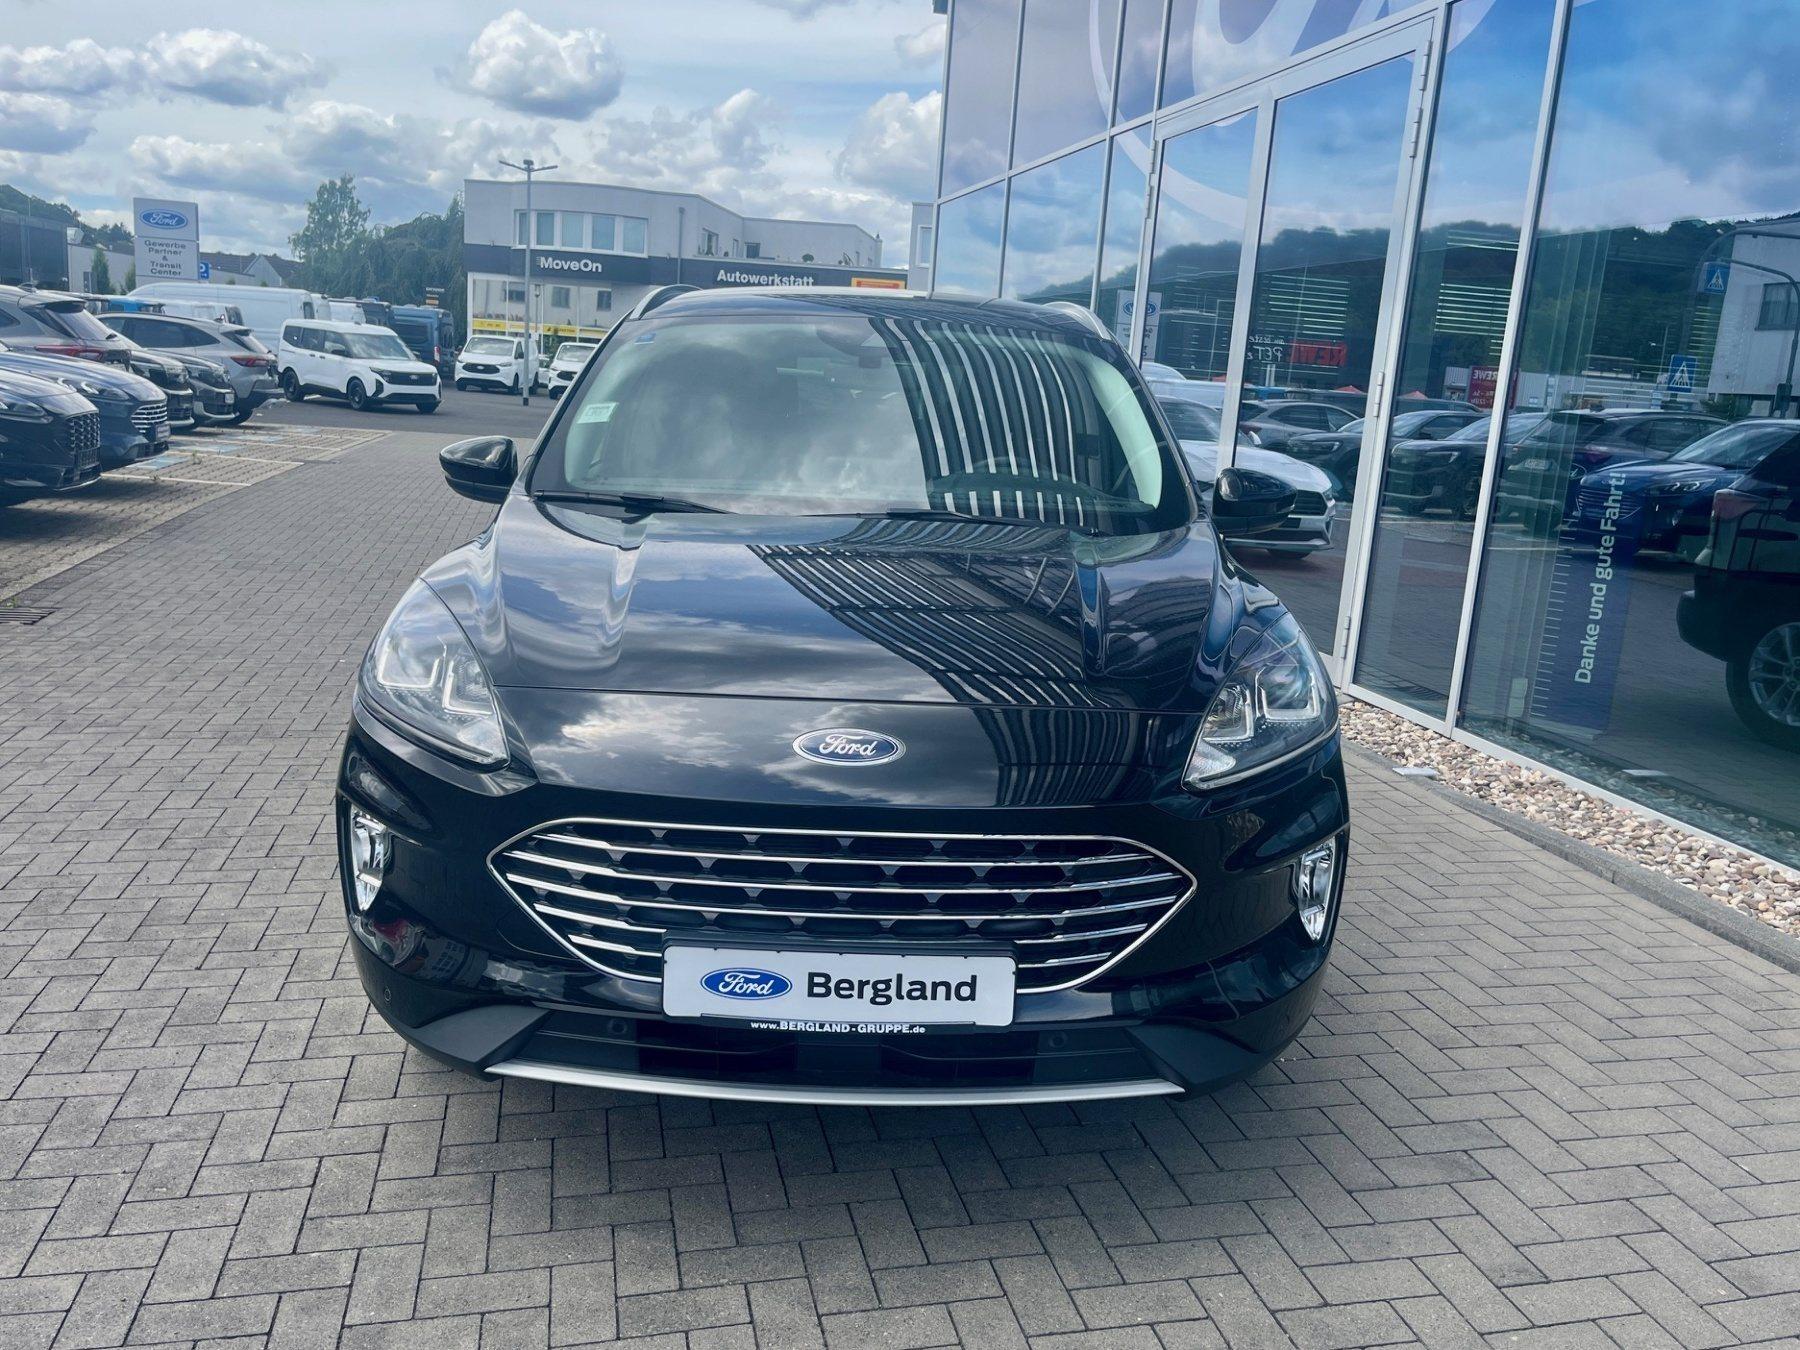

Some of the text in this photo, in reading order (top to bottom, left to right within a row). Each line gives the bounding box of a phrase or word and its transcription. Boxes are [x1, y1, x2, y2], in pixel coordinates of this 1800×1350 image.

[144, 239, 186, 249] Gewerbe
[148, 247, 182, 256] Partner
[150, 261, 183, 269] Transit
[540, 256, 602, 272] MoveOn
[150, 268, 182, 276] Center
[717, 269, 814, 287] Autowerkstatt
[1575, 472, 1626, 684] Danke und gute Fahrt!
[819, 733, 878, 756] Ford
[718, 971, 978, 1006] Ford Bergland
[750, 1021, 926, 1034] www.BERGLAND-GRUPPE.de
